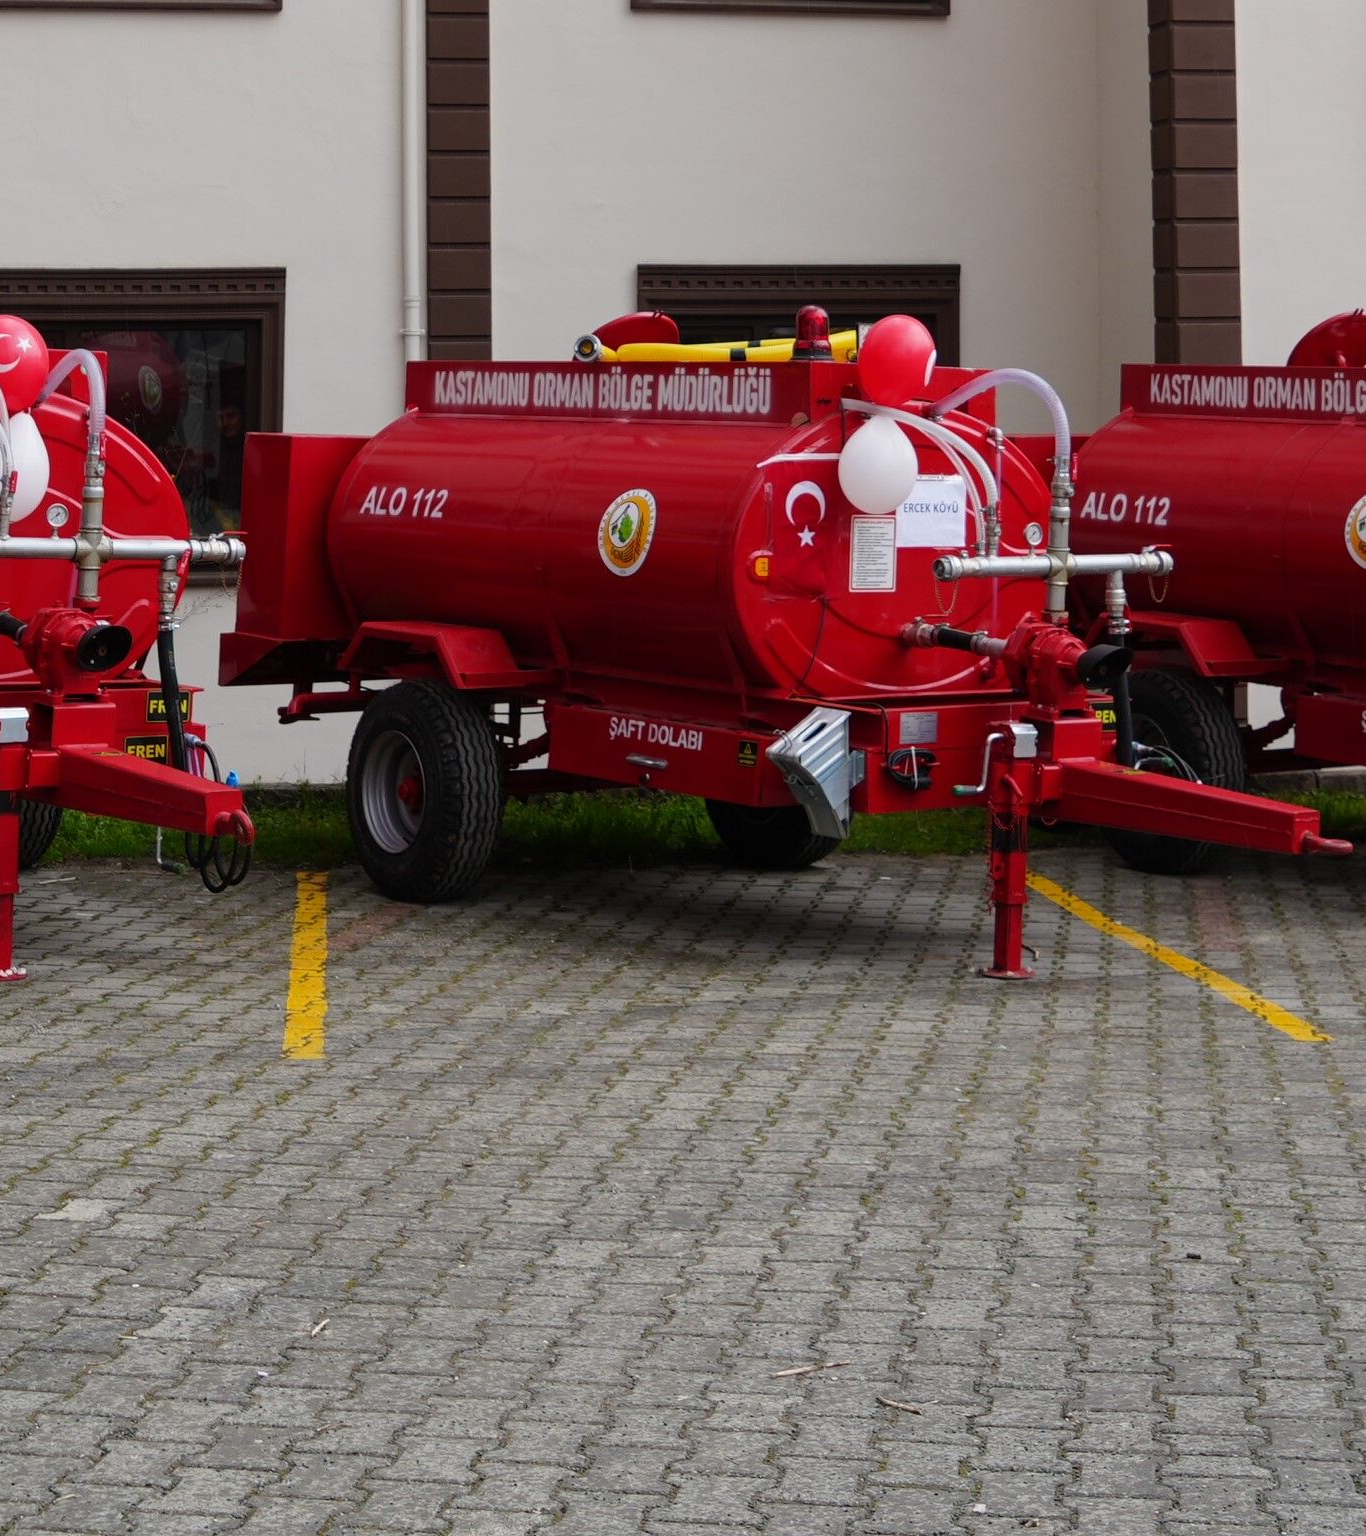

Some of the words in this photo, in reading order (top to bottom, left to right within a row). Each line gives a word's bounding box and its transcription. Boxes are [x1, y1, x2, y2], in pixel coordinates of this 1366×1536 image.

[434, 370, 530, 407] KASTAMONU
[534, 372, 595, 410] ORMAN
[598, 366, 654, 411] BÖLGE
[658, 366, 772, 415] MÜDÜRLÜĞÜ
[1149, 373, 1248, 409] KASTAMONU
[1253, 376, 1316, 411] ORMAN
[359, 485, 408, 516] ALO
[411, 487, 449, 519] 112
[903, 502, 932, 514] ERCEK
[933, 500, 960, 514] KÖYÜ
[1079, 491, 1128, 522] ALO
[1133, 495, 1171, 526] 112
[149, 698, 187, 715] FRN
[1094, 708, 1117, 724] REN
[126, 743, 166, 759] FREN
[608, 716, 646, 741] ŞAFT
[647, 723, 704, 752] DOLABI
